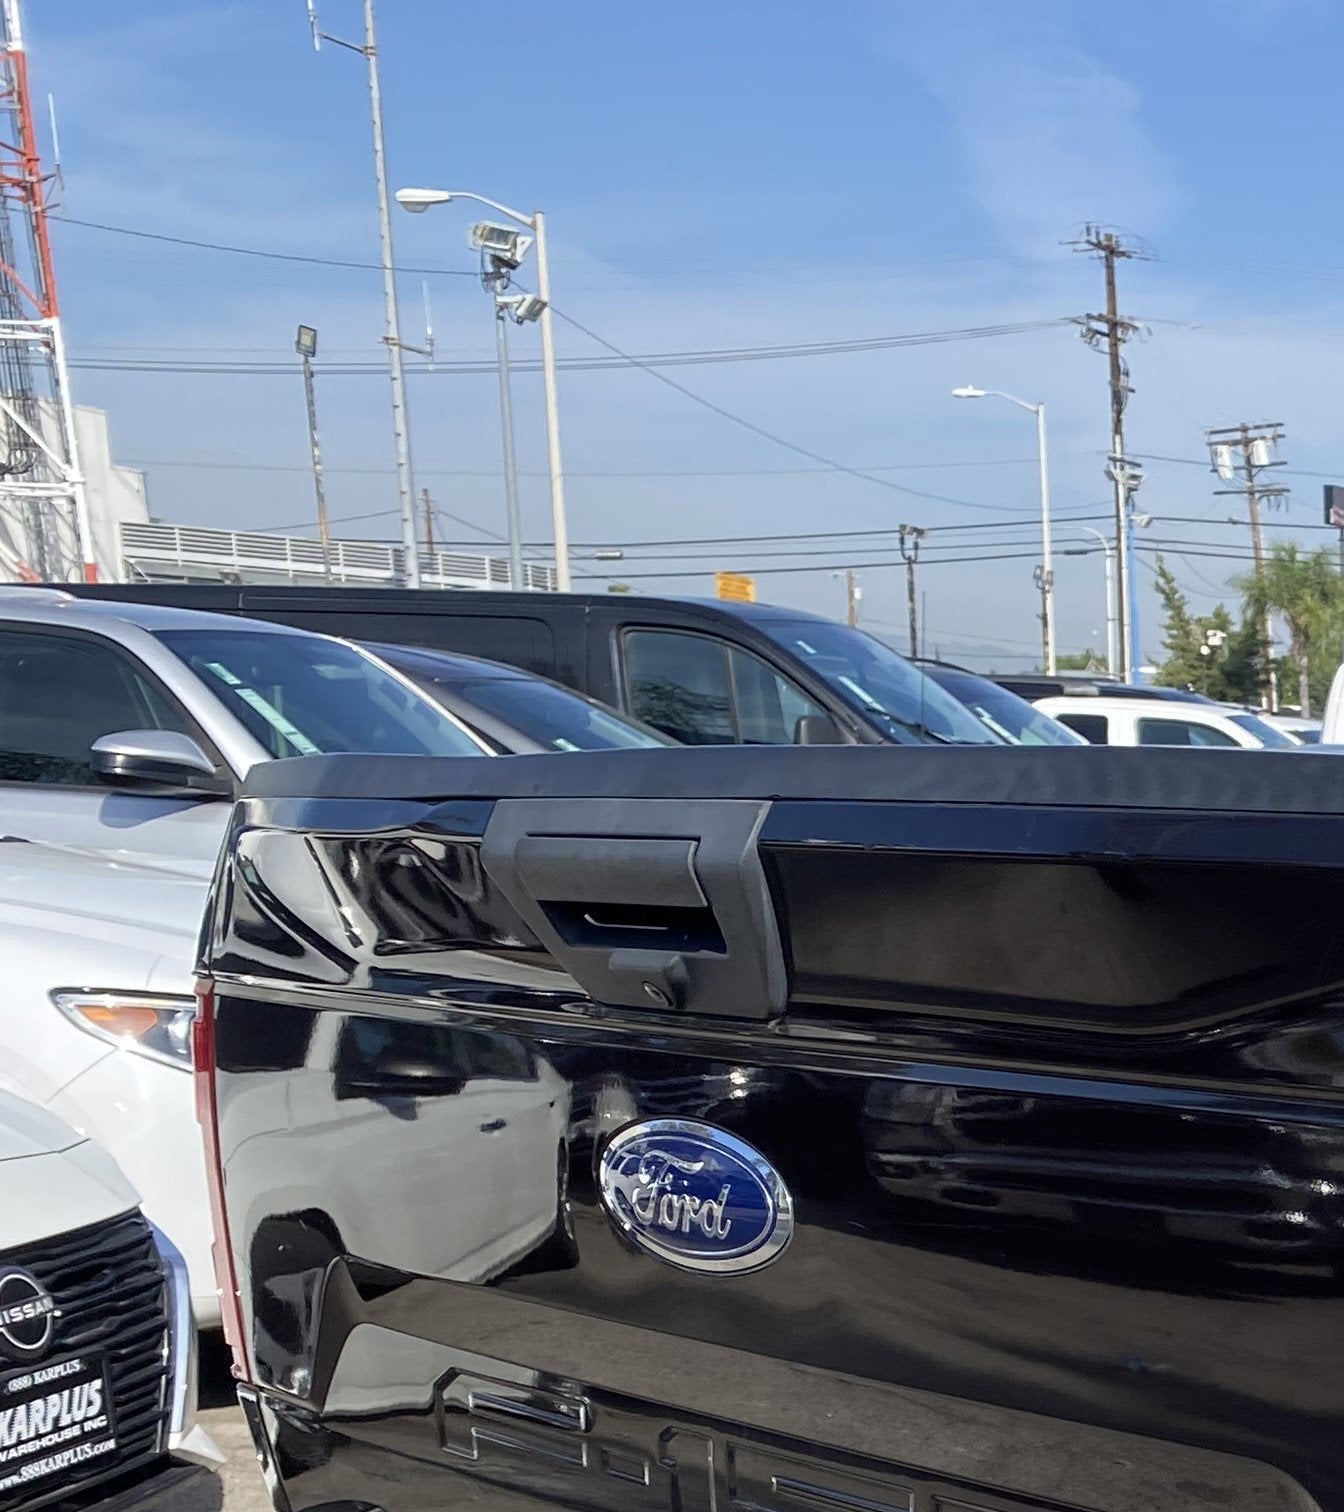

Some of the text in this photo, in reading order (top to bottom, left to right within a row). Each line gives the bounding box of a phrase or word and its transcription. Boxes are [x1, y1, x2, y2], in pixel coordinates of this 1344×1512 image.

[632, 1149, 731, 1240] Ford
[0, 1296, 53, 1326] ISSAN
[33, 1359, 80, 1385] KARPLUS
[83, 1414, 108, 1432] INC
